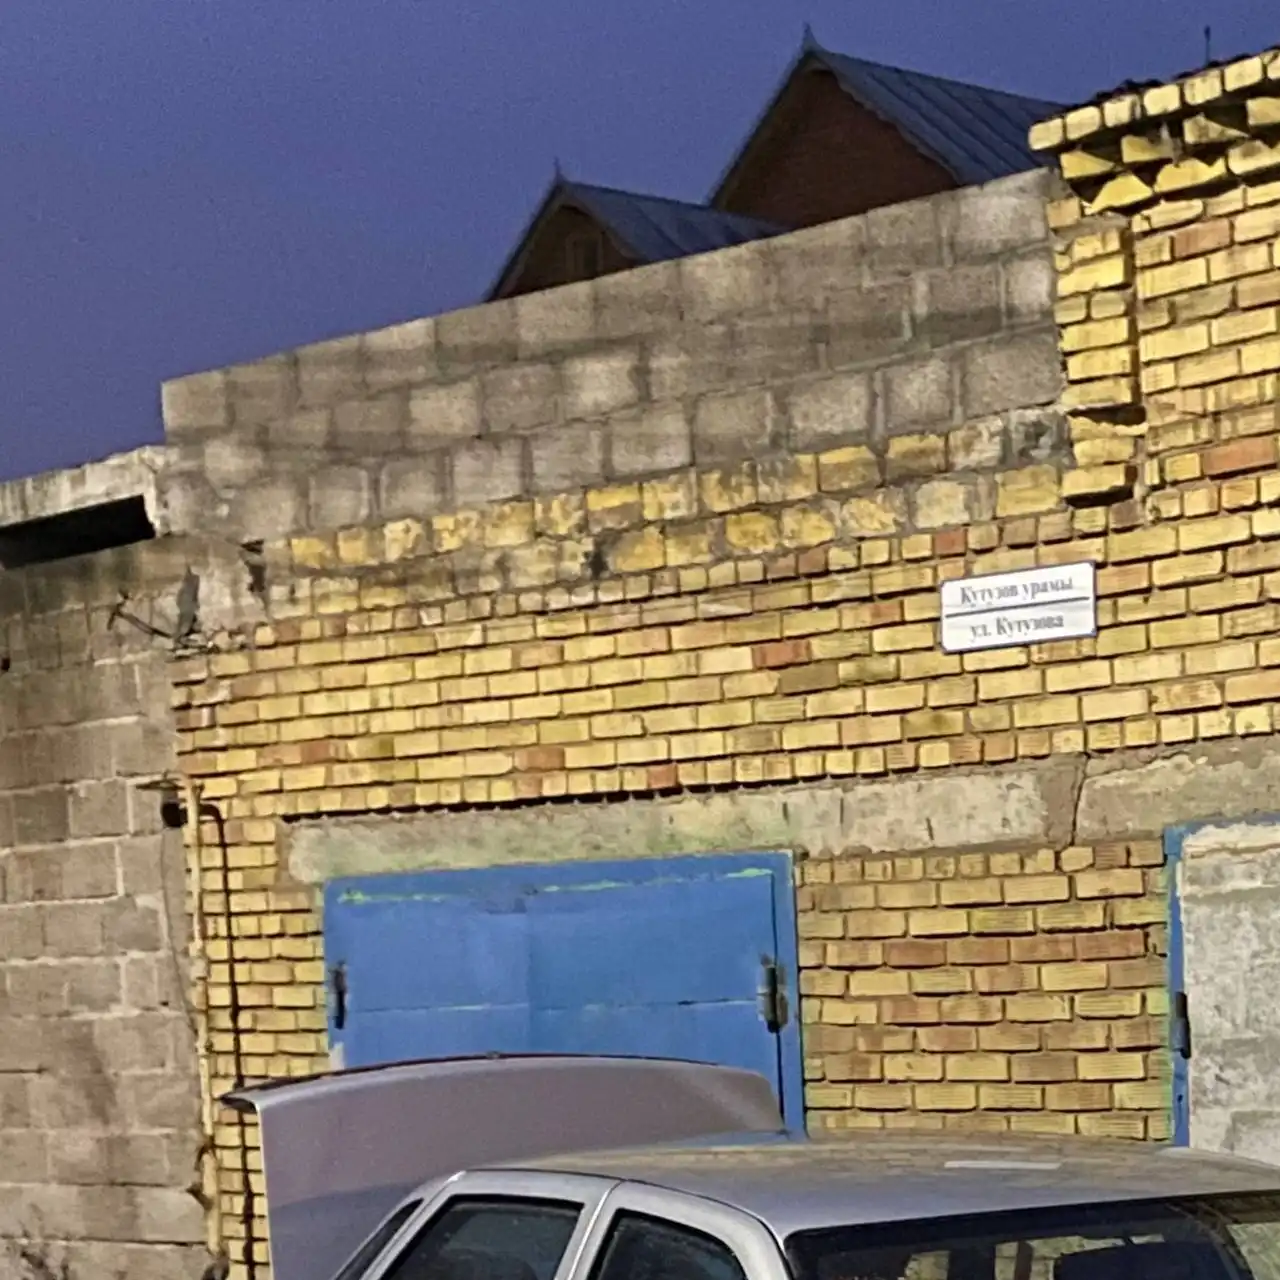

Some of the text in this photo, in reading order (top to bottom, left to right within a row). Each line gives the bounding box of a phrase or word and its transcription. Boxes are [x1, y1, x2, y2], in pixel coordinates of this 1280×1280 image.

[960, 577, 1073, 608] Кутузов урамы
[970, 614, 1064, 643] ул. Кутузова
